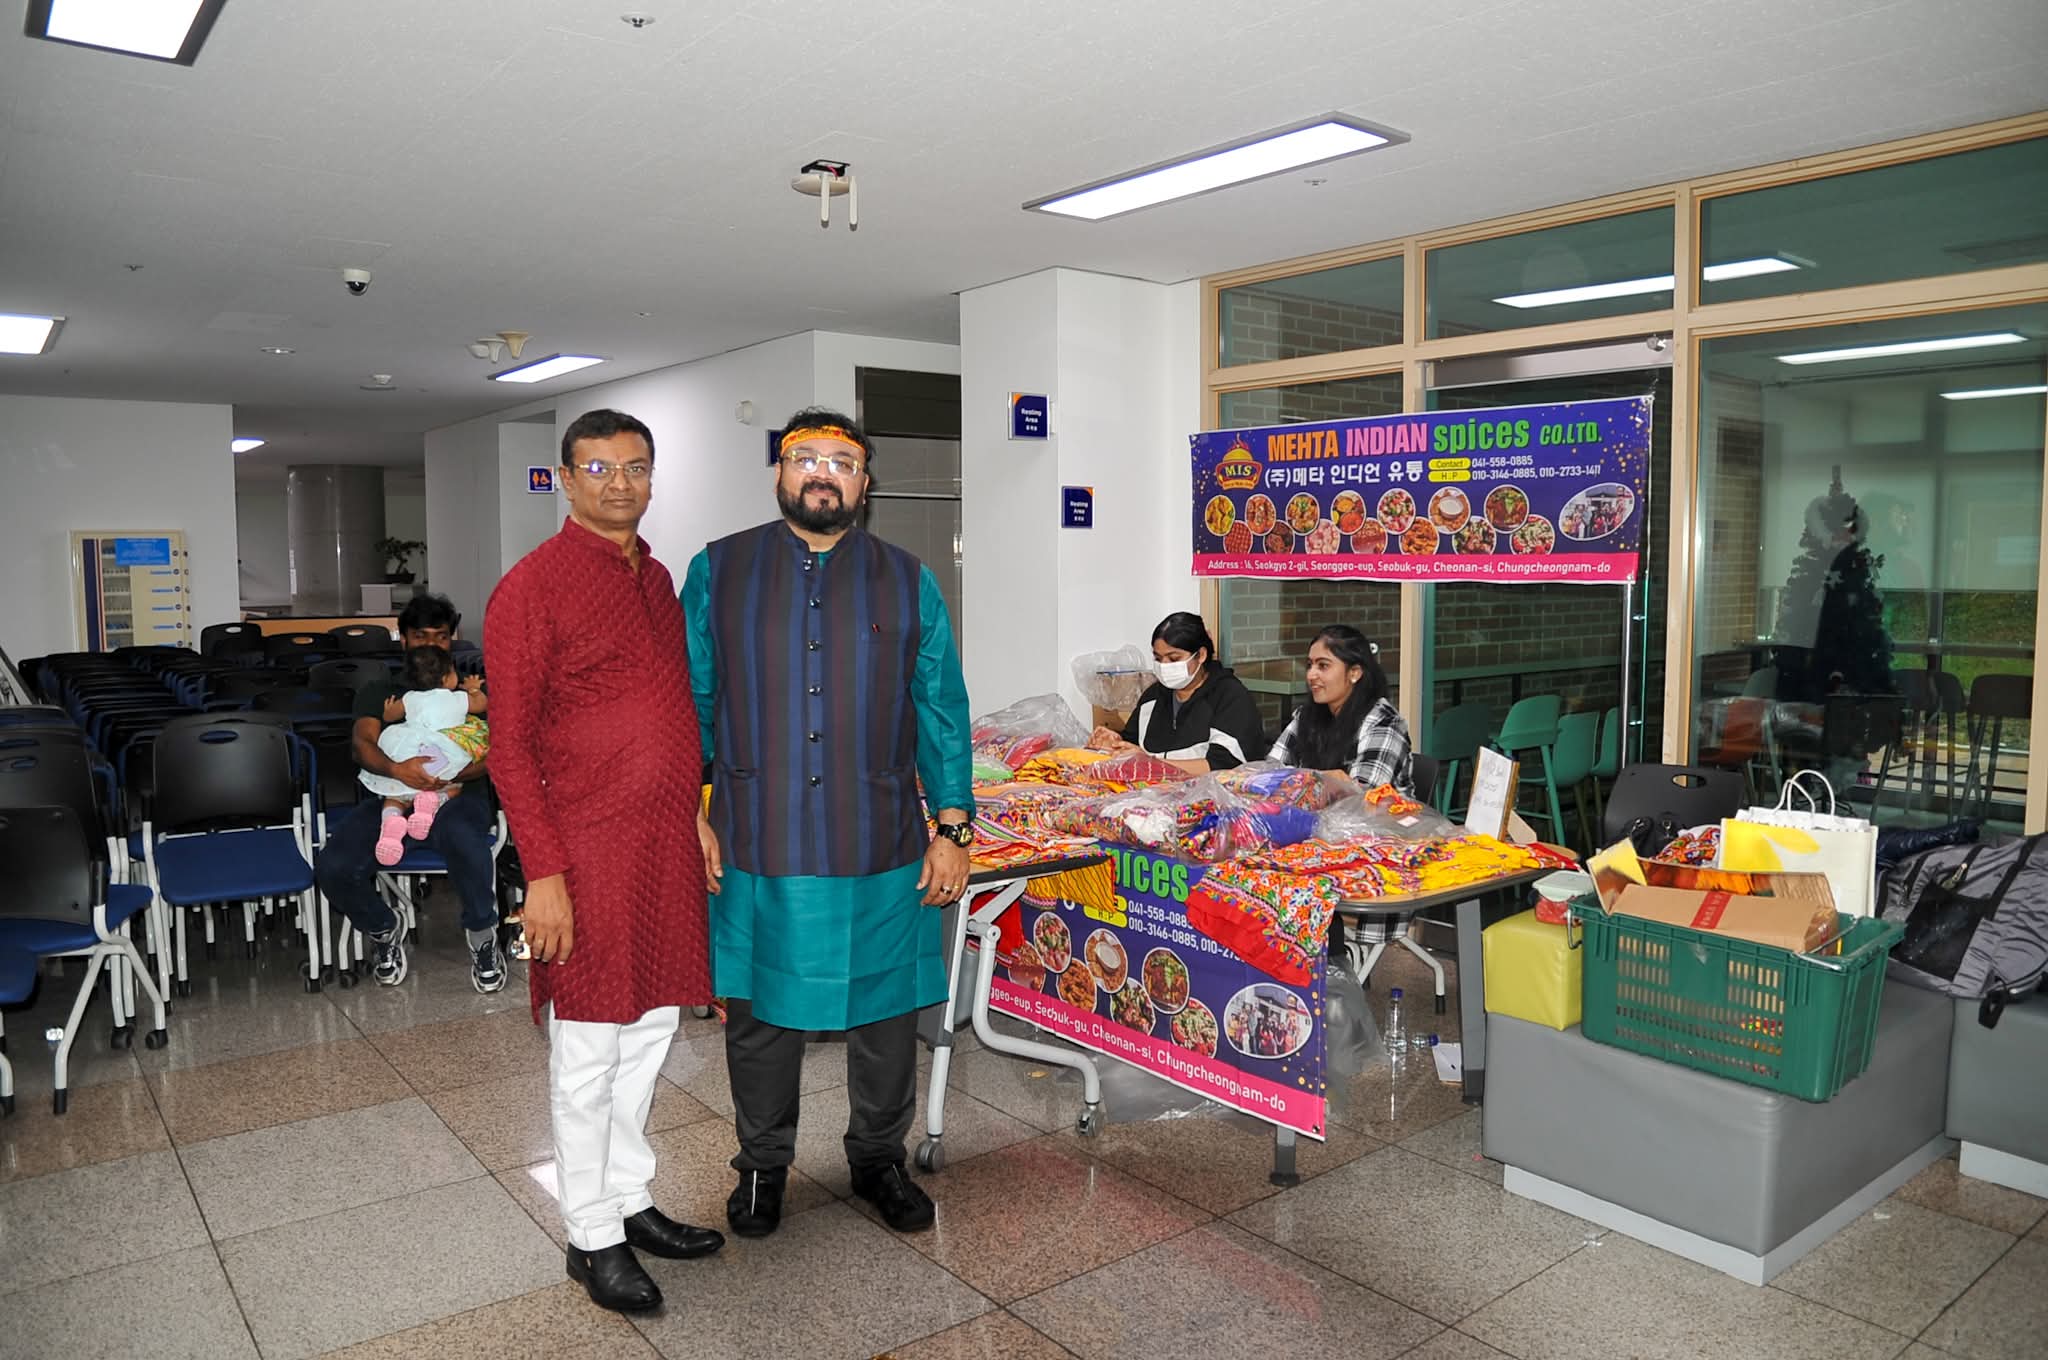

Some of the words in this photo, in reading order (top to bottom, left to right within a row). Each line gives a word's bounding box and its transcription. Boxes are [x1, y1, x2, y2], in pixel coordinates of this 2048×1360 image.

[1267, 430, 1339, 462] MEHTA
[1346, 423, 1428, 457] INDIAN
[1224, 464, 1253, 478] MIS
[1264, 464, 1325, 489] (주)메타
[1330, 462, 1381, 485] 인디언
[1387, 460, 1424, 483] 유통
[1435, 459, 1464, 469] Contact
[1471, 455, 1534, 468] 041-558-0885
[1471, 467, 1538, 481] 010-3146-0885,
[1208, 559, 1239, 570] Address
[1254, 559, 1287, 573] Seokgyo
[1310, 560, 1376, 574] Seonggeo-eup,
[1378, 561, 1430, 575] Seobuk-gu,
[1433, 562, 1495, 574] Cheonan-si,
[1497, 561, 1611, 575] Chungcheongnam-do
[1128, 900, 1193, 930] 041-558-088
[1128, 917, 1199, 951] 010-3146-0885,
[1092, 1023, 1154, 1063] Cheonan-si,
[1157, 1049, 1287, 1113] Chungcheongnam-do
